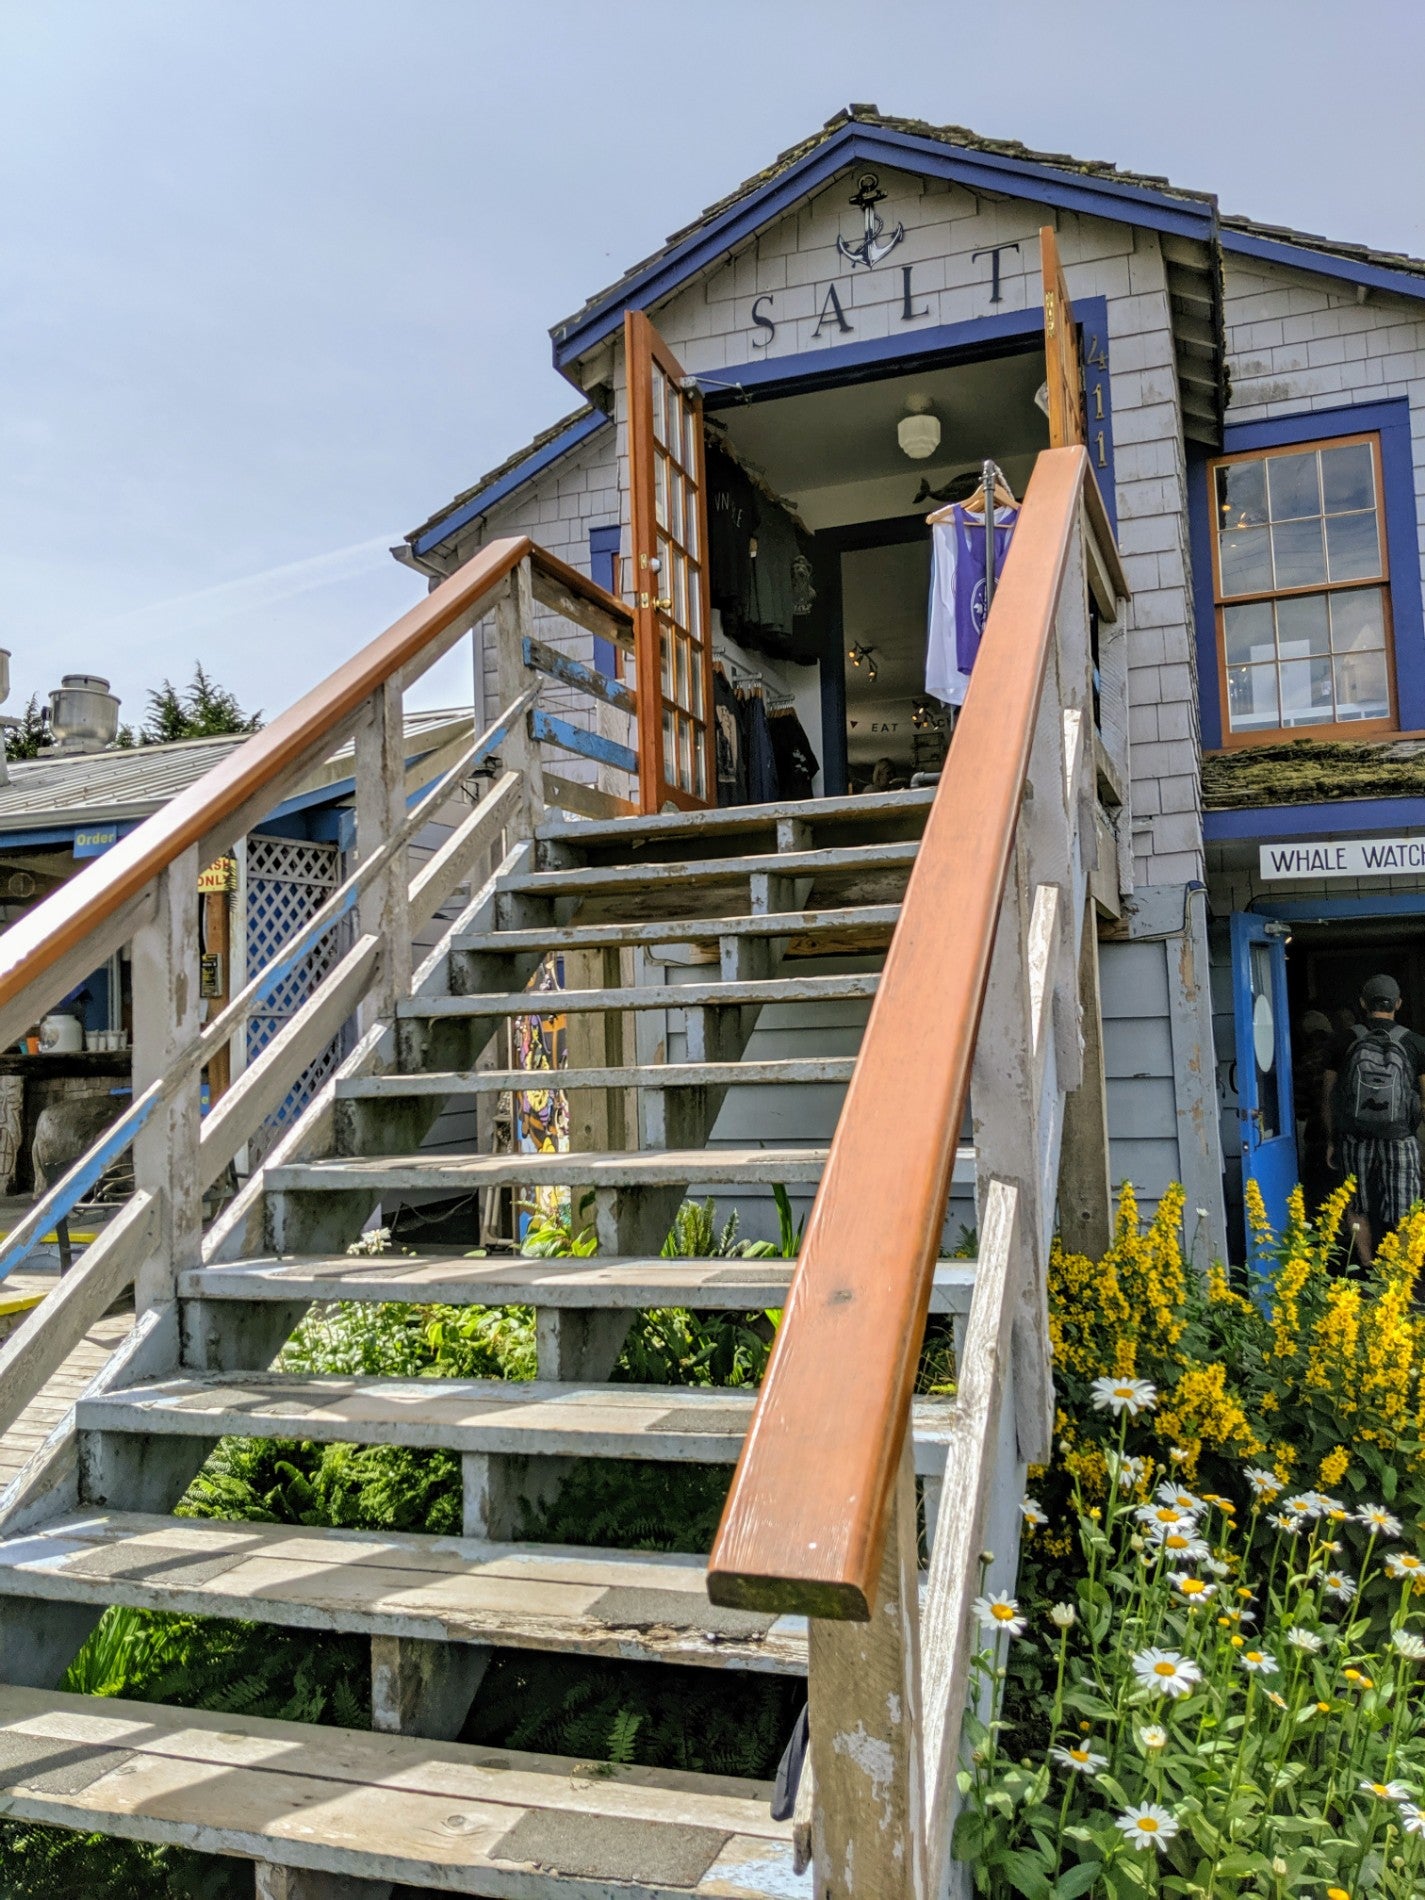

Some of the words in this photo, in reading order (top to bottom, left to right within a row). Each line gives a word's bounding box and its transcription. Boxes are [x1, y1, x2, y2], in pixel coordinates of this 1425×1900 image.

[751, 243, 1020, 348] SALT
[1087, 335, 1109, 468] 411
[871, 723, 899, 733] EAT
[76, 832, 115, 847] Order
[1270, 847, 1348, 873] WHALE
